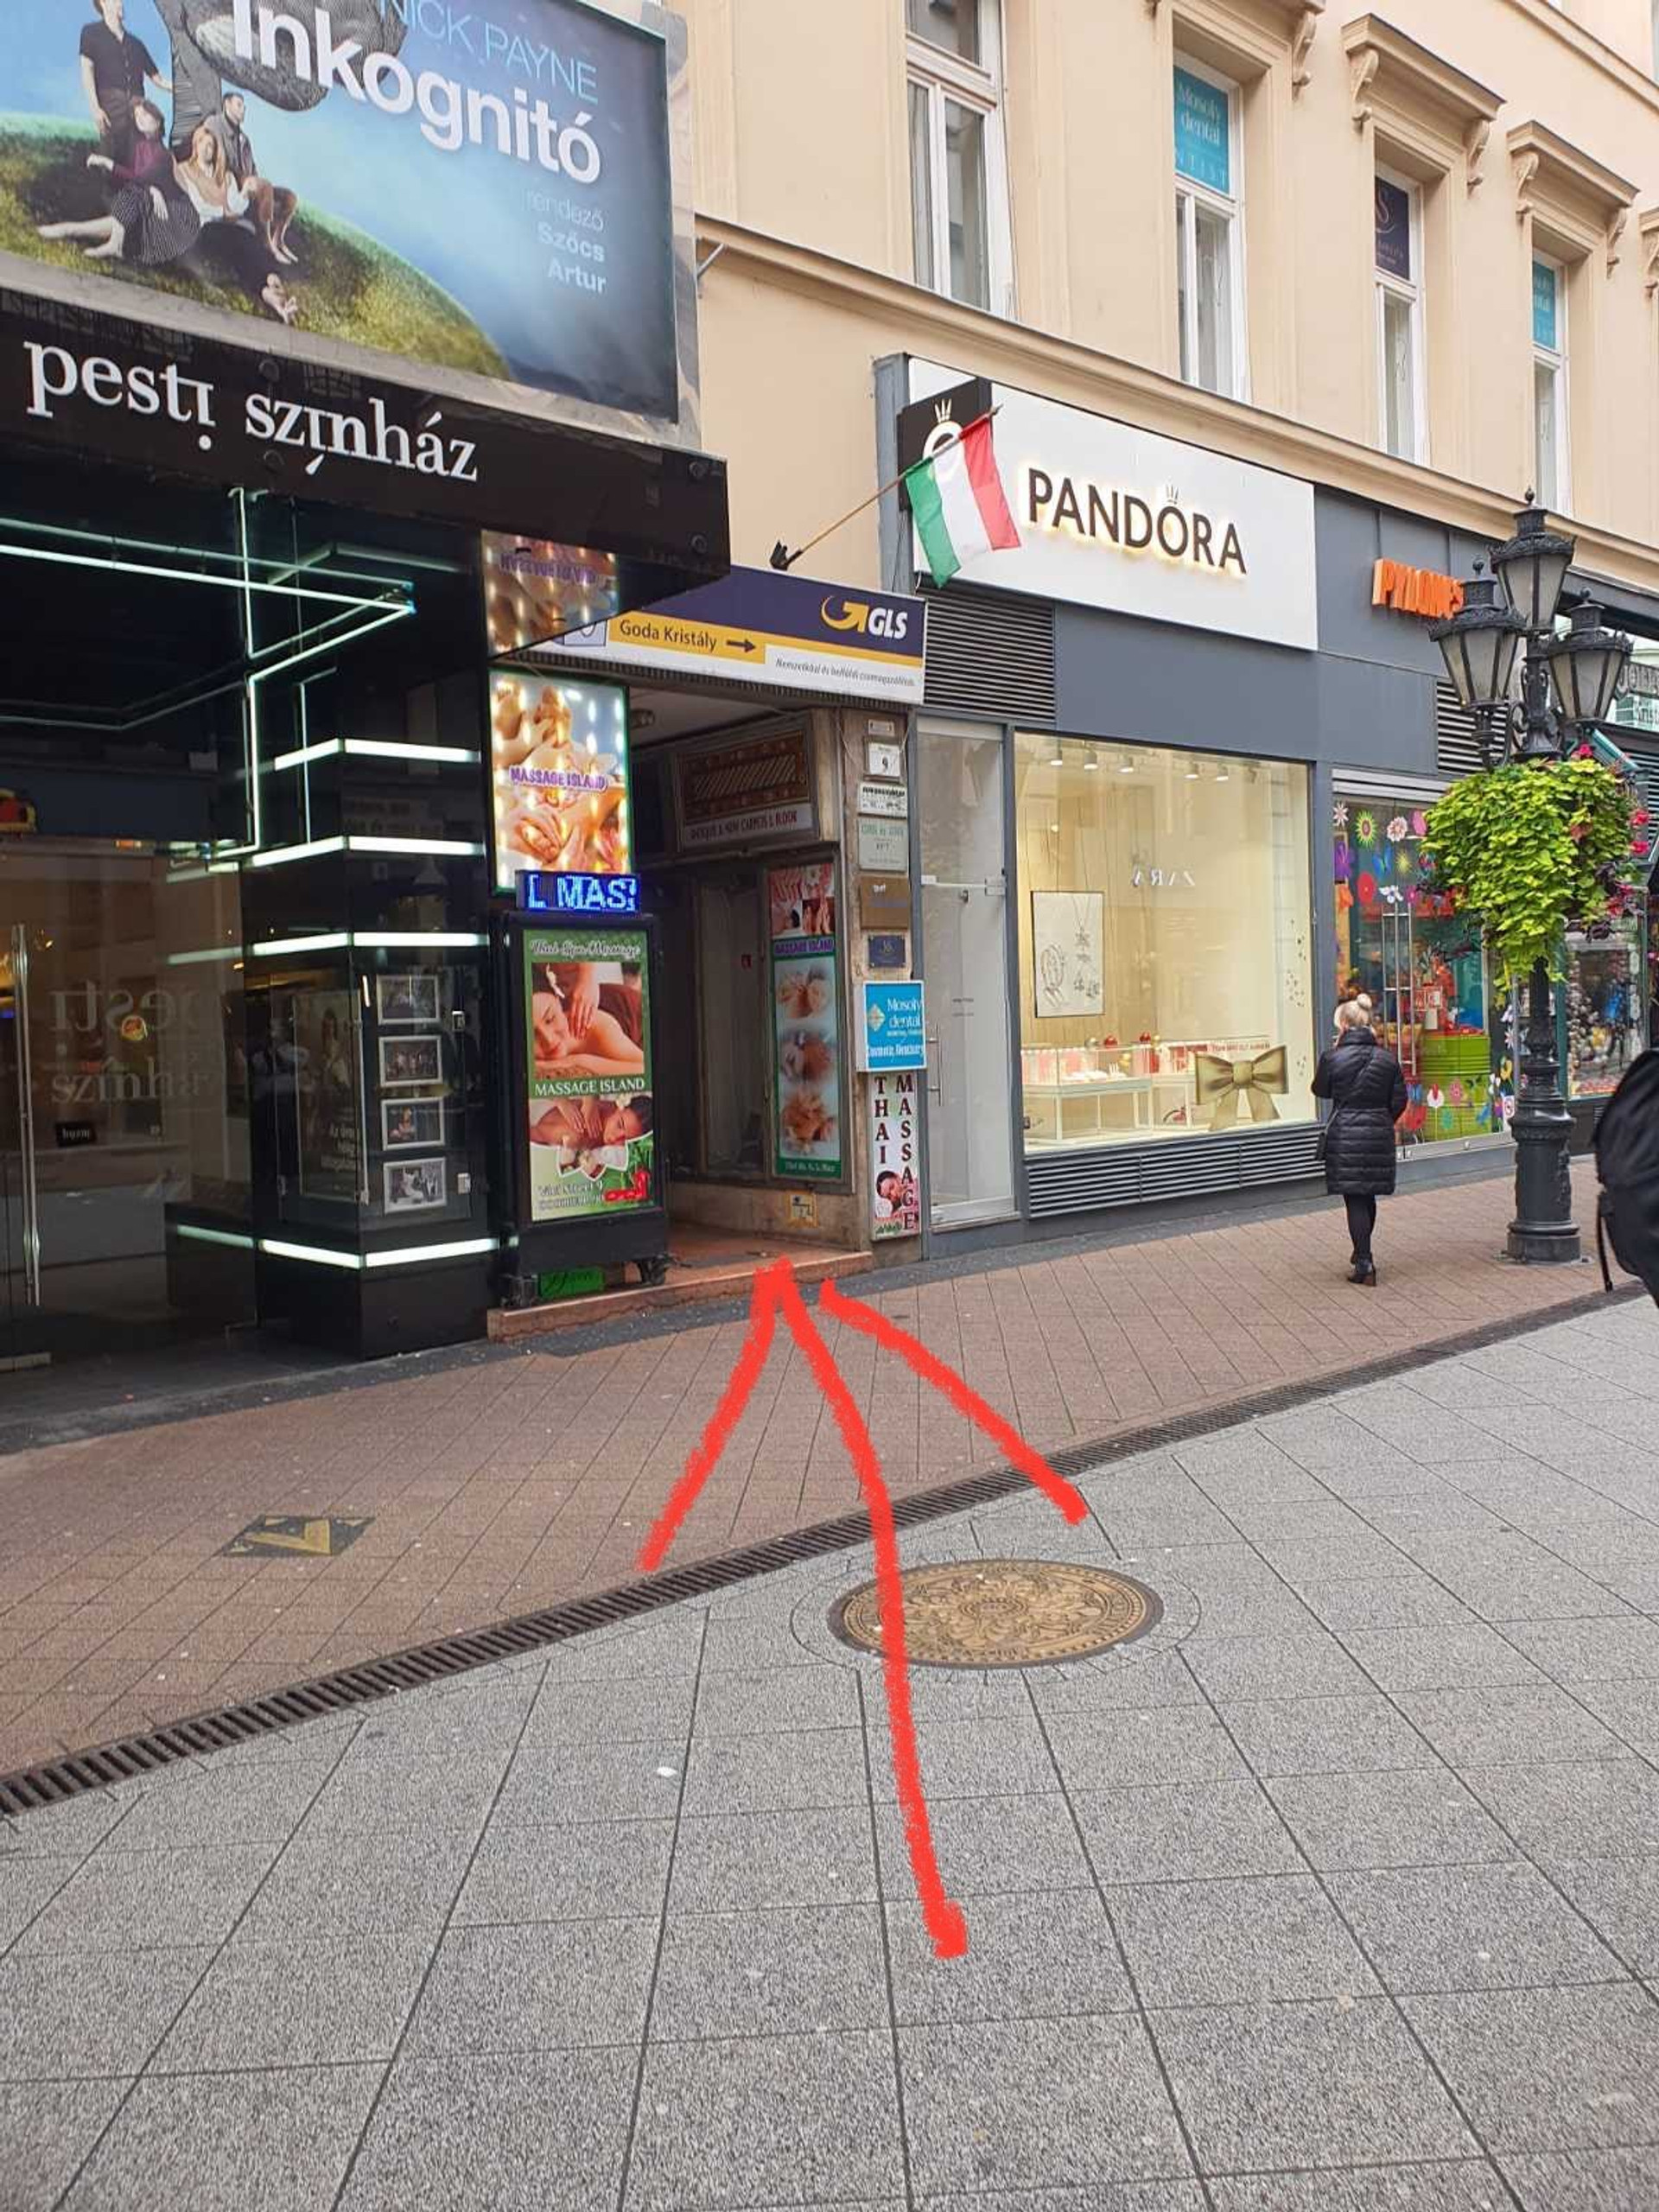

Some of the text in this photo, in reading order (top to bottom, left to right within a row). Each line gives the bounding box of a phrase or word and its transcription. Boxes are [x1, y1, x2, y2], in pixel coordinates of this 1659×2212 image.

[485, 22, 600, 104] PAYNE
[232, 0, 601, 184] Inkognitó
[537, 220, 605, 263] Szőcs
[548, 257, 607, 295] Artur
[1028, 467, 1247, 575] PANDORA
[620, 619, 717, 652] Goda Kristály
[868, 607, 908, 640] GLS
[510, 766, 608, 792] MASSAGE ISLAND
[887, 996, 923, 1013] Mosoly
[889, 1013, 921, 1028] dental
[534, 1077, 645, 1096] MASSAGE ISLAND
[874, 1076, 890, 1165] THAI
[895, 1073, 914, 1231] MASSAGE
